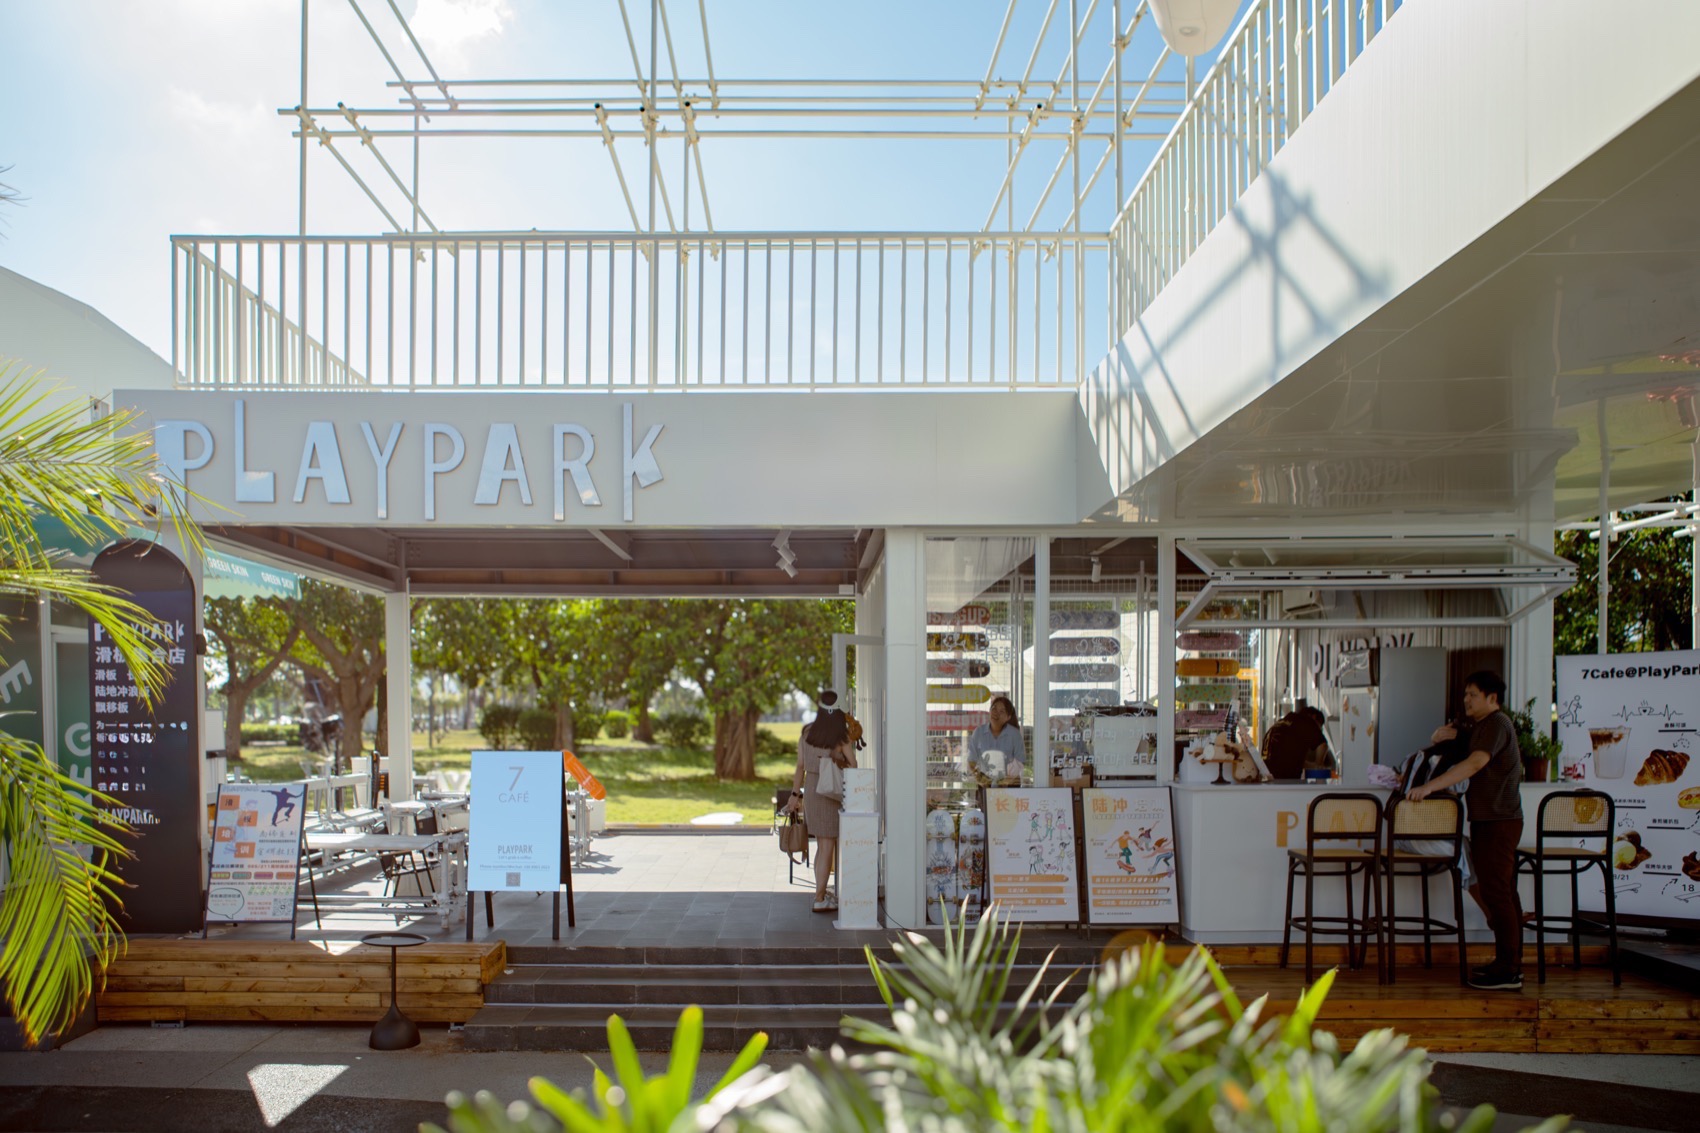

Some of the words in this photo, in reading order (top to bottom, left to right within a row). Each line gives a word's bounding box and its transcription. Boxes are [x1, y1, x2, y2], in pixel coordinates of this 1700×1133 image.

[155, 399, 665, 521] PLAYPARK
[207, 556, 231, 573] GREEN
[230, 563, 249, 577] SKIN
[508, 766, 525, 792] 7
[498, 791, 529, 803] CAFÉ
[498, 845, 533, 854] PLAYPARK
[1682, 884, 1695, 892] 18
